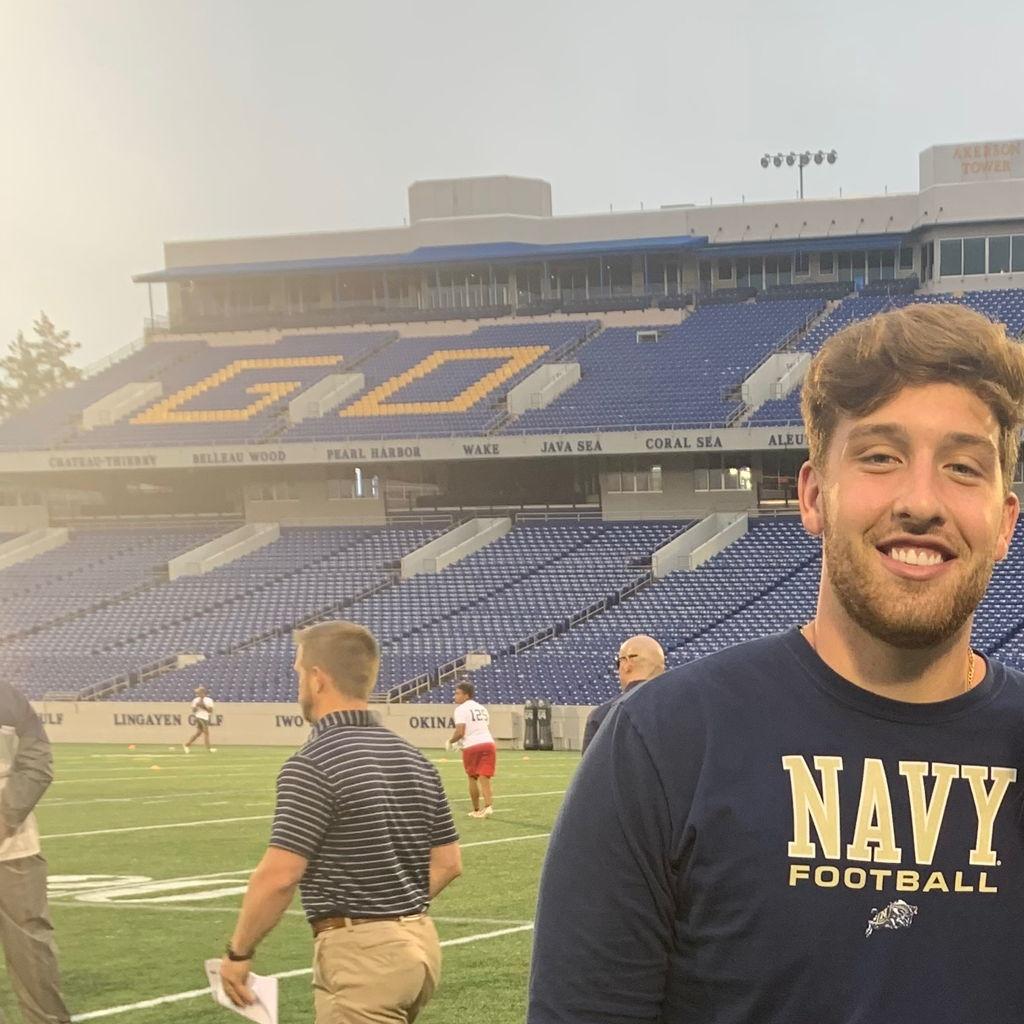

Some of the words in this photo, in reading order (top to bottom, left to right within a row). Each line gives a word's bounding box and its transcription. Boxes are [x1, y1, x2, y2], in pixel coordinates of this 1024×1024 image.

[961, 160, 1012, 174] TOWER
[645, 437, 691, 449] CORAL
[697, 435, 722, 448] SEA
[768, 433, 804, 446] ALEU
[463, 444, 500, 456] WAKE
[541, 441, 572, 453] JAVA
[577, 440, 602, 452] SEA
[192, 453, 244, 464] BELLEAU
[250, 451, 286, 462] WOOD
[327, 449, 366, 460] PEARL
[371, 447, 421, 459] HARBOR
[40, 712, 63, 725] ULF
[114, 713, 181, 726] LINGAYEN
[188, 714, 223, 727] GLF
[275, 715, 304, 727] IWO
[470, 709, 488, 722] 125
[409, 716, 456, 729] OKINA
[782, 755, 1017, 866] NAVY
[789, 864, 998, 893] FOOTBALL
